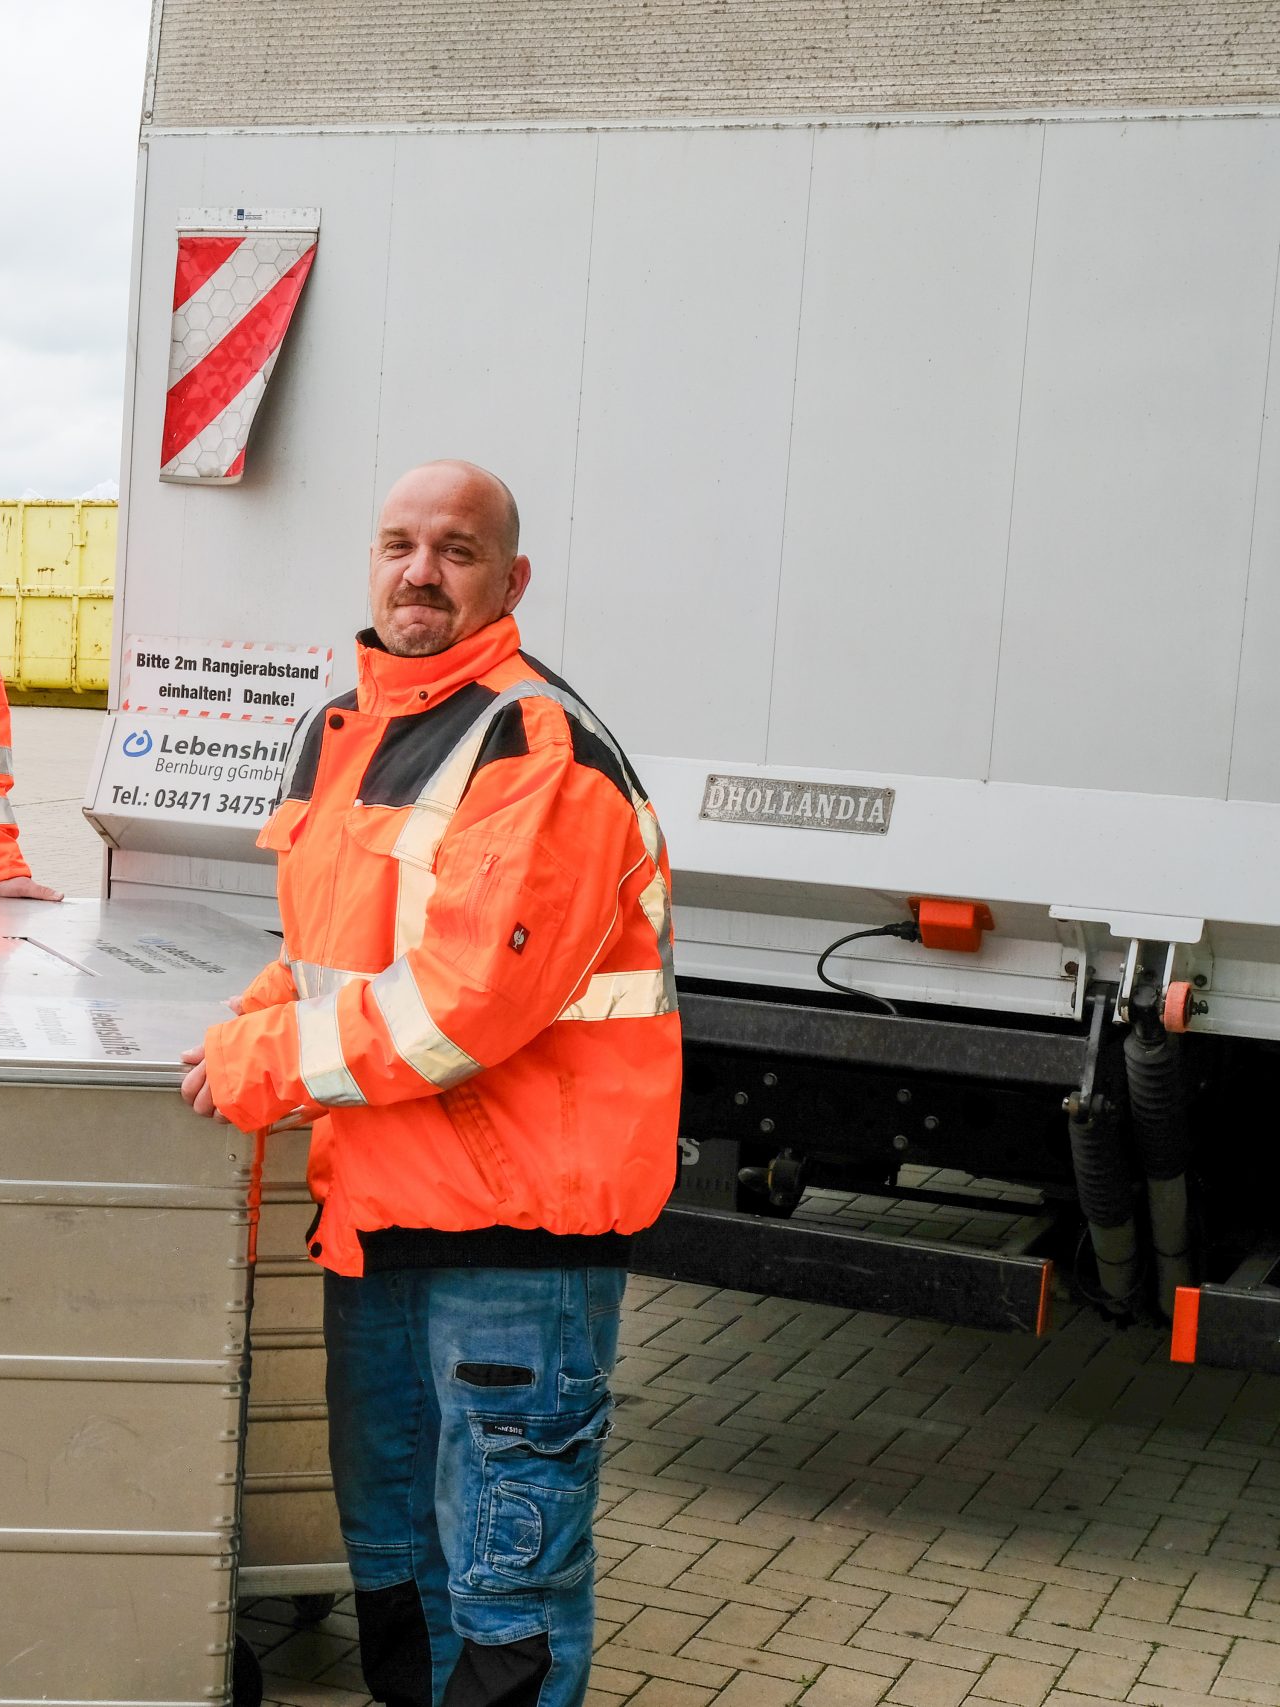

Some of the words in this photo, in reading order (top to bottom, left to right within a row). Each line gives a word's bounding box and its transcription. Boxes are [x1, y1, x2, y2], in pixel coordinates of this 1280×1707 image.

[136, 652, 170, 669] Bitte
[174, 656, 197, 671] 2m
[202, 658, 319, 680] Rangierabstand
[159, 683, 232, 702] einhalten!
[243, 689, 295, 707] Danke!
[160, 734, 288, 762] Lebenshil
[155, 757, 224, 781] Bernburg
[227, 764, 284, 782] gGmbH
[112, 786, 150, 806] Tel.:
[154, 789, 211, 811] 03471
[216, 794, 277, 816] 34751
[706, 785, 886, 824] DHOLLANDIA
[86, 1008, 141, 1056] Lebenshilfe
